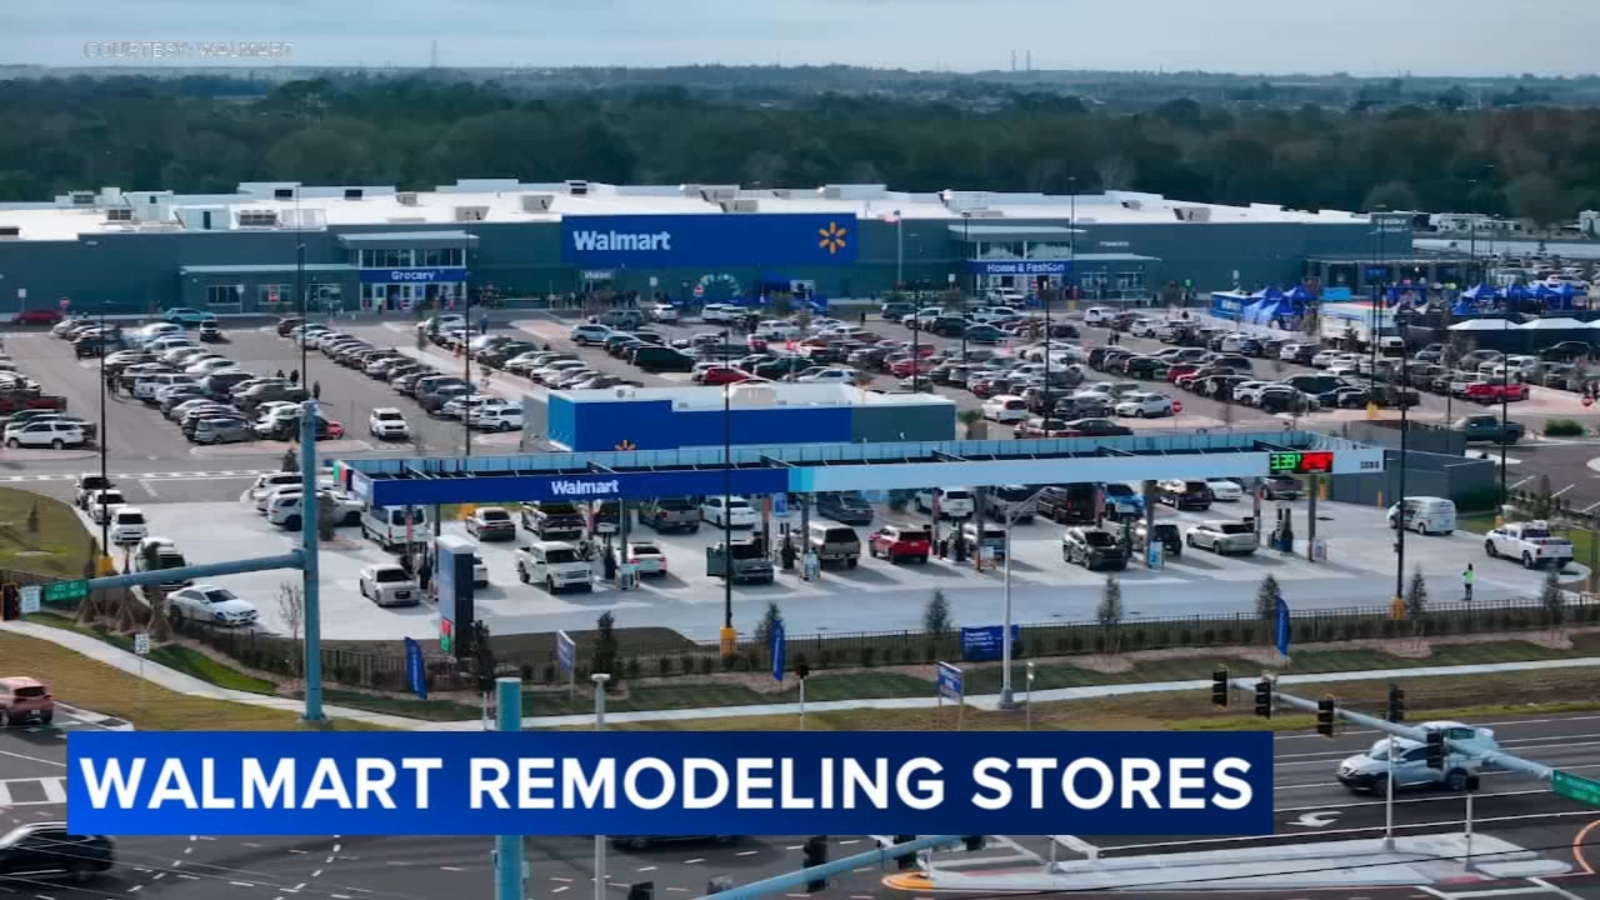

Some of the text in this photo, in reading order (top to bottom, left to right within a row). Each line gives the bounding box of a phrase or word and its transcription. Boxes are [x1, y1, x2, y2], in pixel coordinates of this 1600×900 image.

[573, 230, 671, 251] Walmart
[986, 262, 1016, 273] Home
[391, 269, 435, 282] Grocery
[551, 480, 619, 495] Walmart
